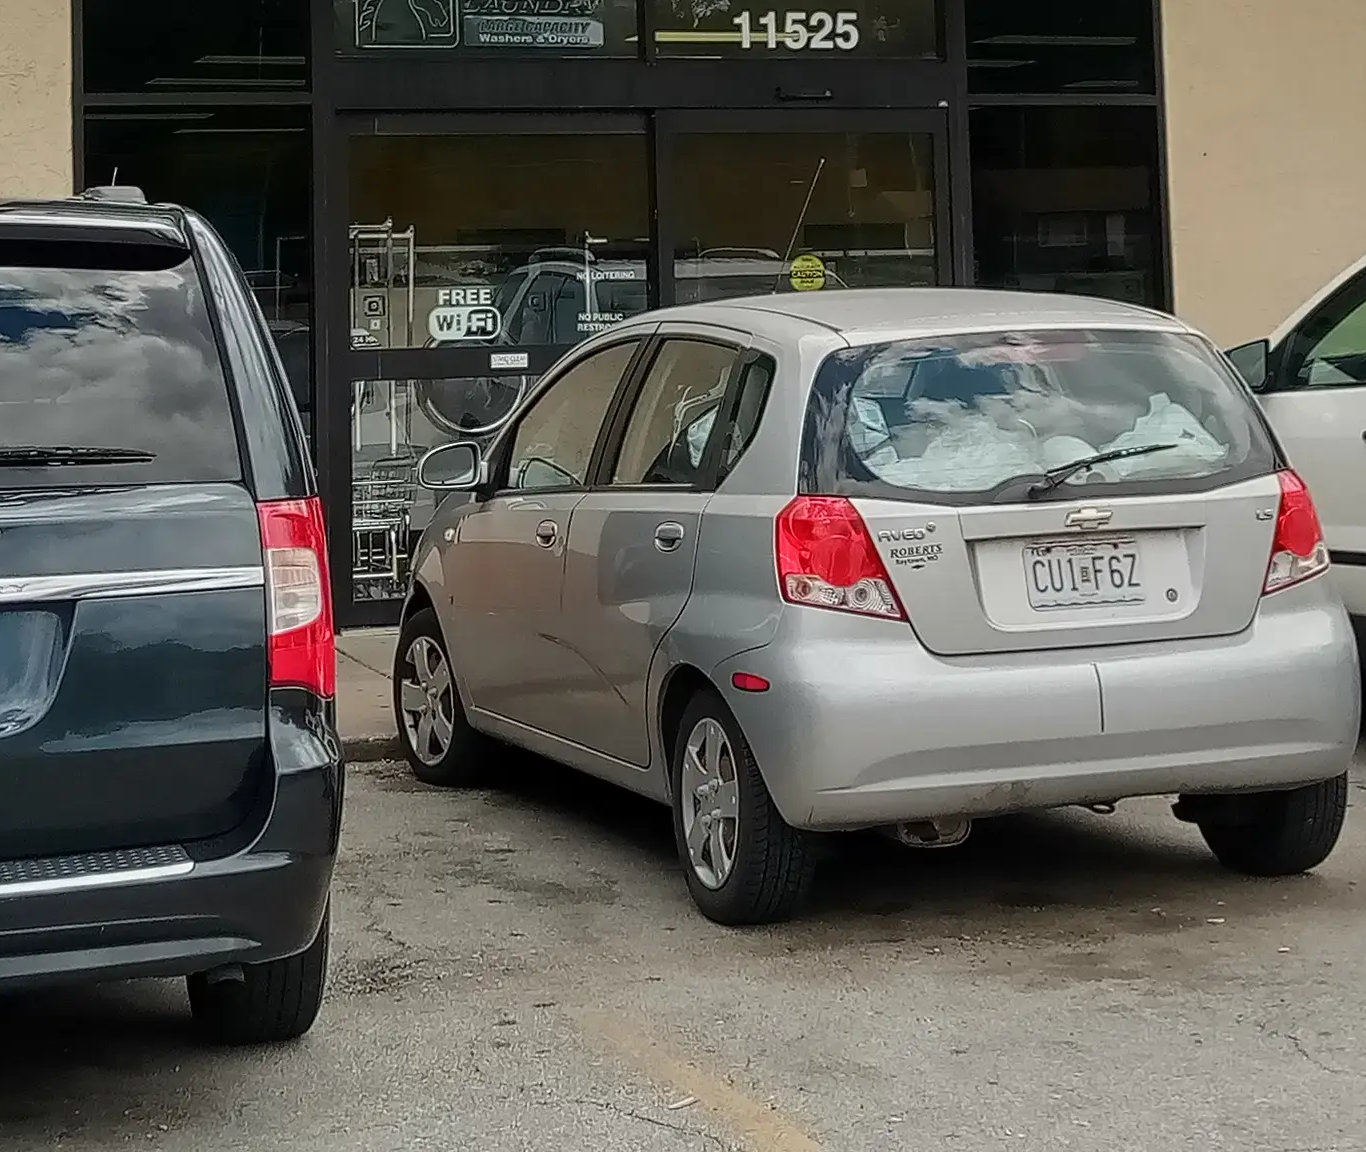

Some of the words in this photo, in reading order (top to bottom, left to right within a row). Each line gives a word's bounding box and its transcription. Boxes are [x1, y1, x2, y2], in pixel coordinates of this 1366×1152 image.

[524, 21, 590, 34] CAPACITY
[733, 10, 859, 49] 11525
[479, 34, 533, 43] Washers
[536, 34, 545, 43] &
[548, 35, 589, 45] Dryers
[591, 270, 635, 279] LOITERING
[438, 289, 492, 305] FREE
[578, 312, 591, 321] NO
[592, 312, 624, 321] PUBLIC
[878, 529, 926, 542] AVEO
[890, 543, 944, 559] ROBERTS
